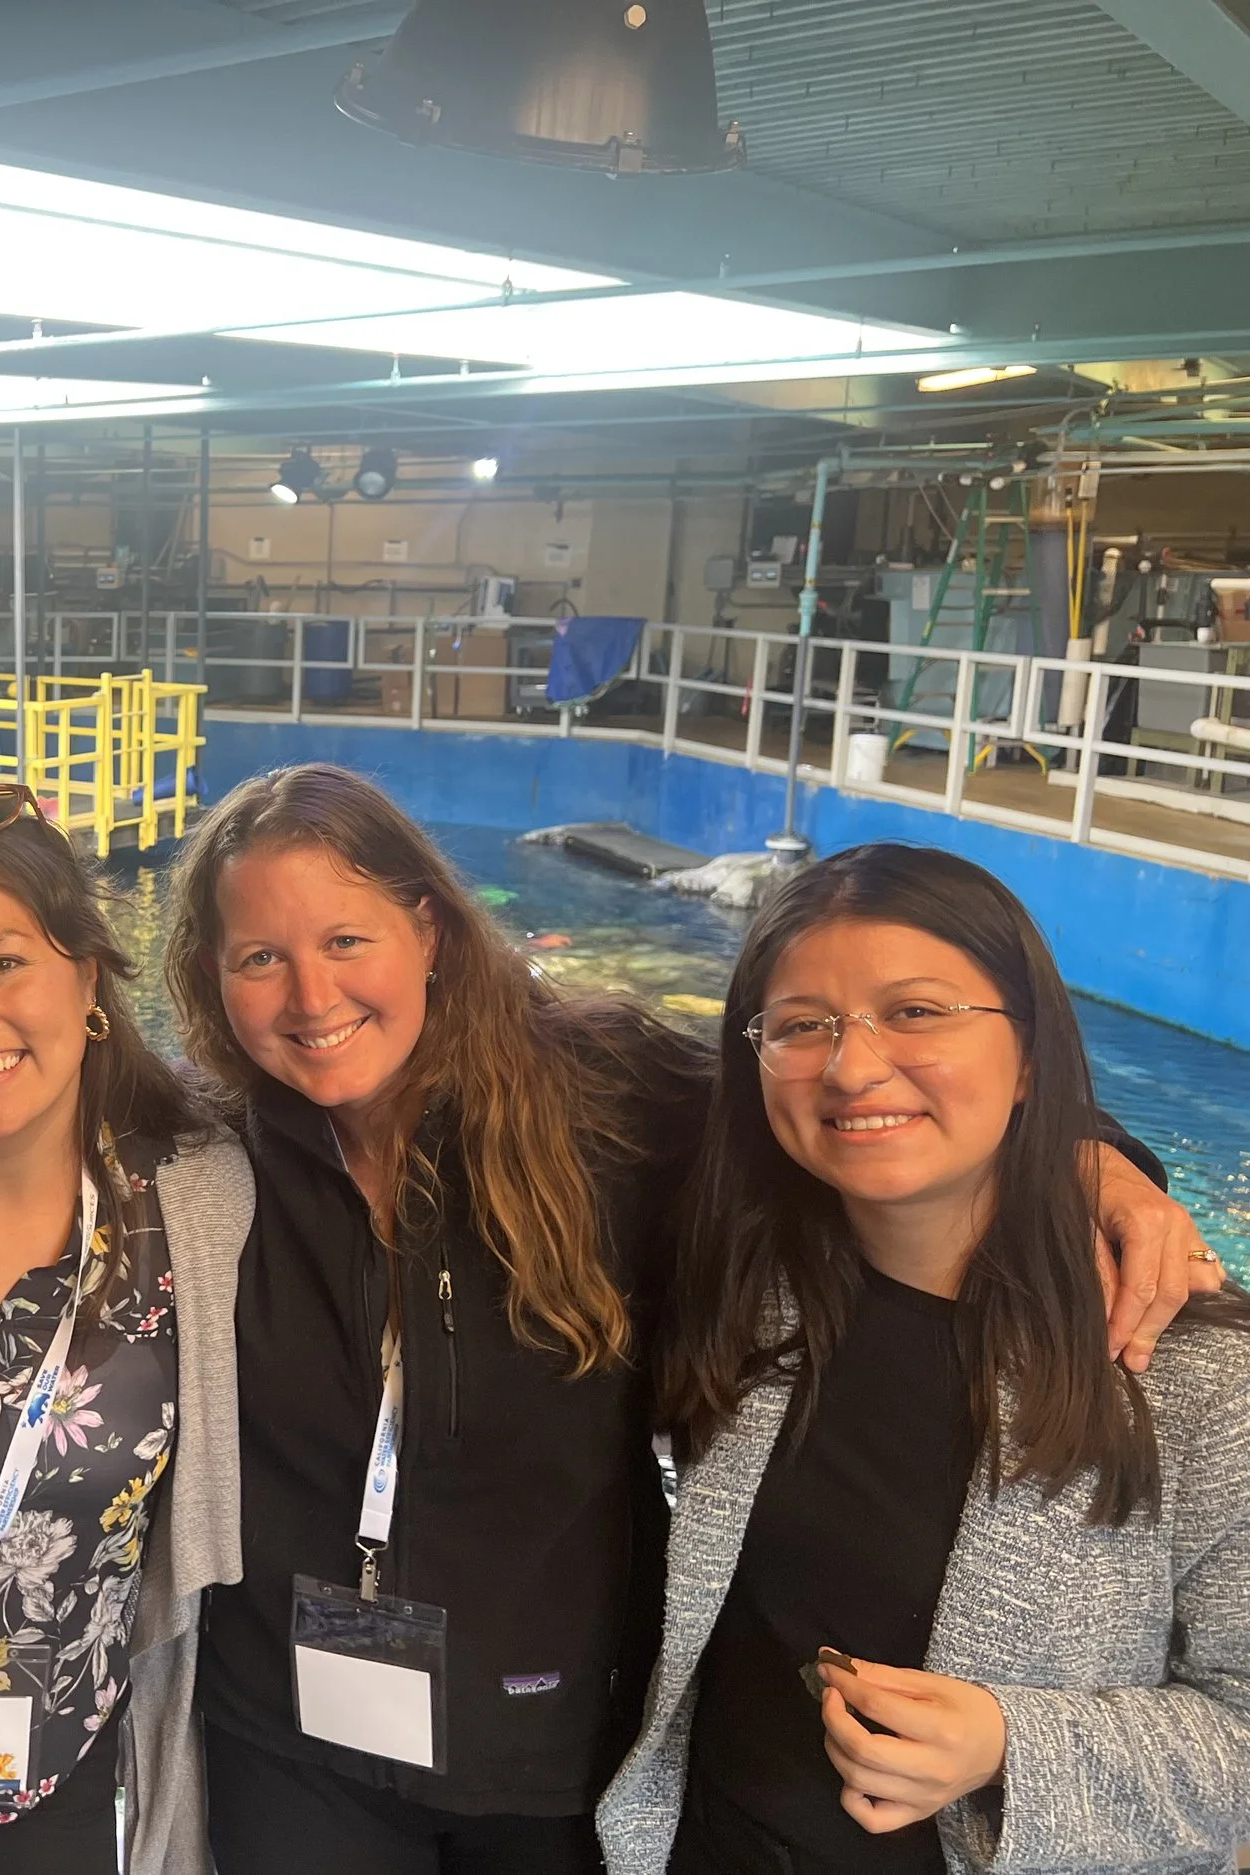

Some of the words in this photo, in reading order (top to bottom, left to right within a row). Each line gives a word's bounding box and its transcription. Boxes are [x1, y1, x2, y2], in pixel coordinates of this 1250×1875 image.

[36, 1369, 48, 1388] SAVE
[42, 1373, 52, 1390] OUR
[48, 1365, 60, 1392] WATER
[374, 1418, 390, 1466] CALIFORNIA
[2, 1468, 19, 1509] EFFICIENCY
